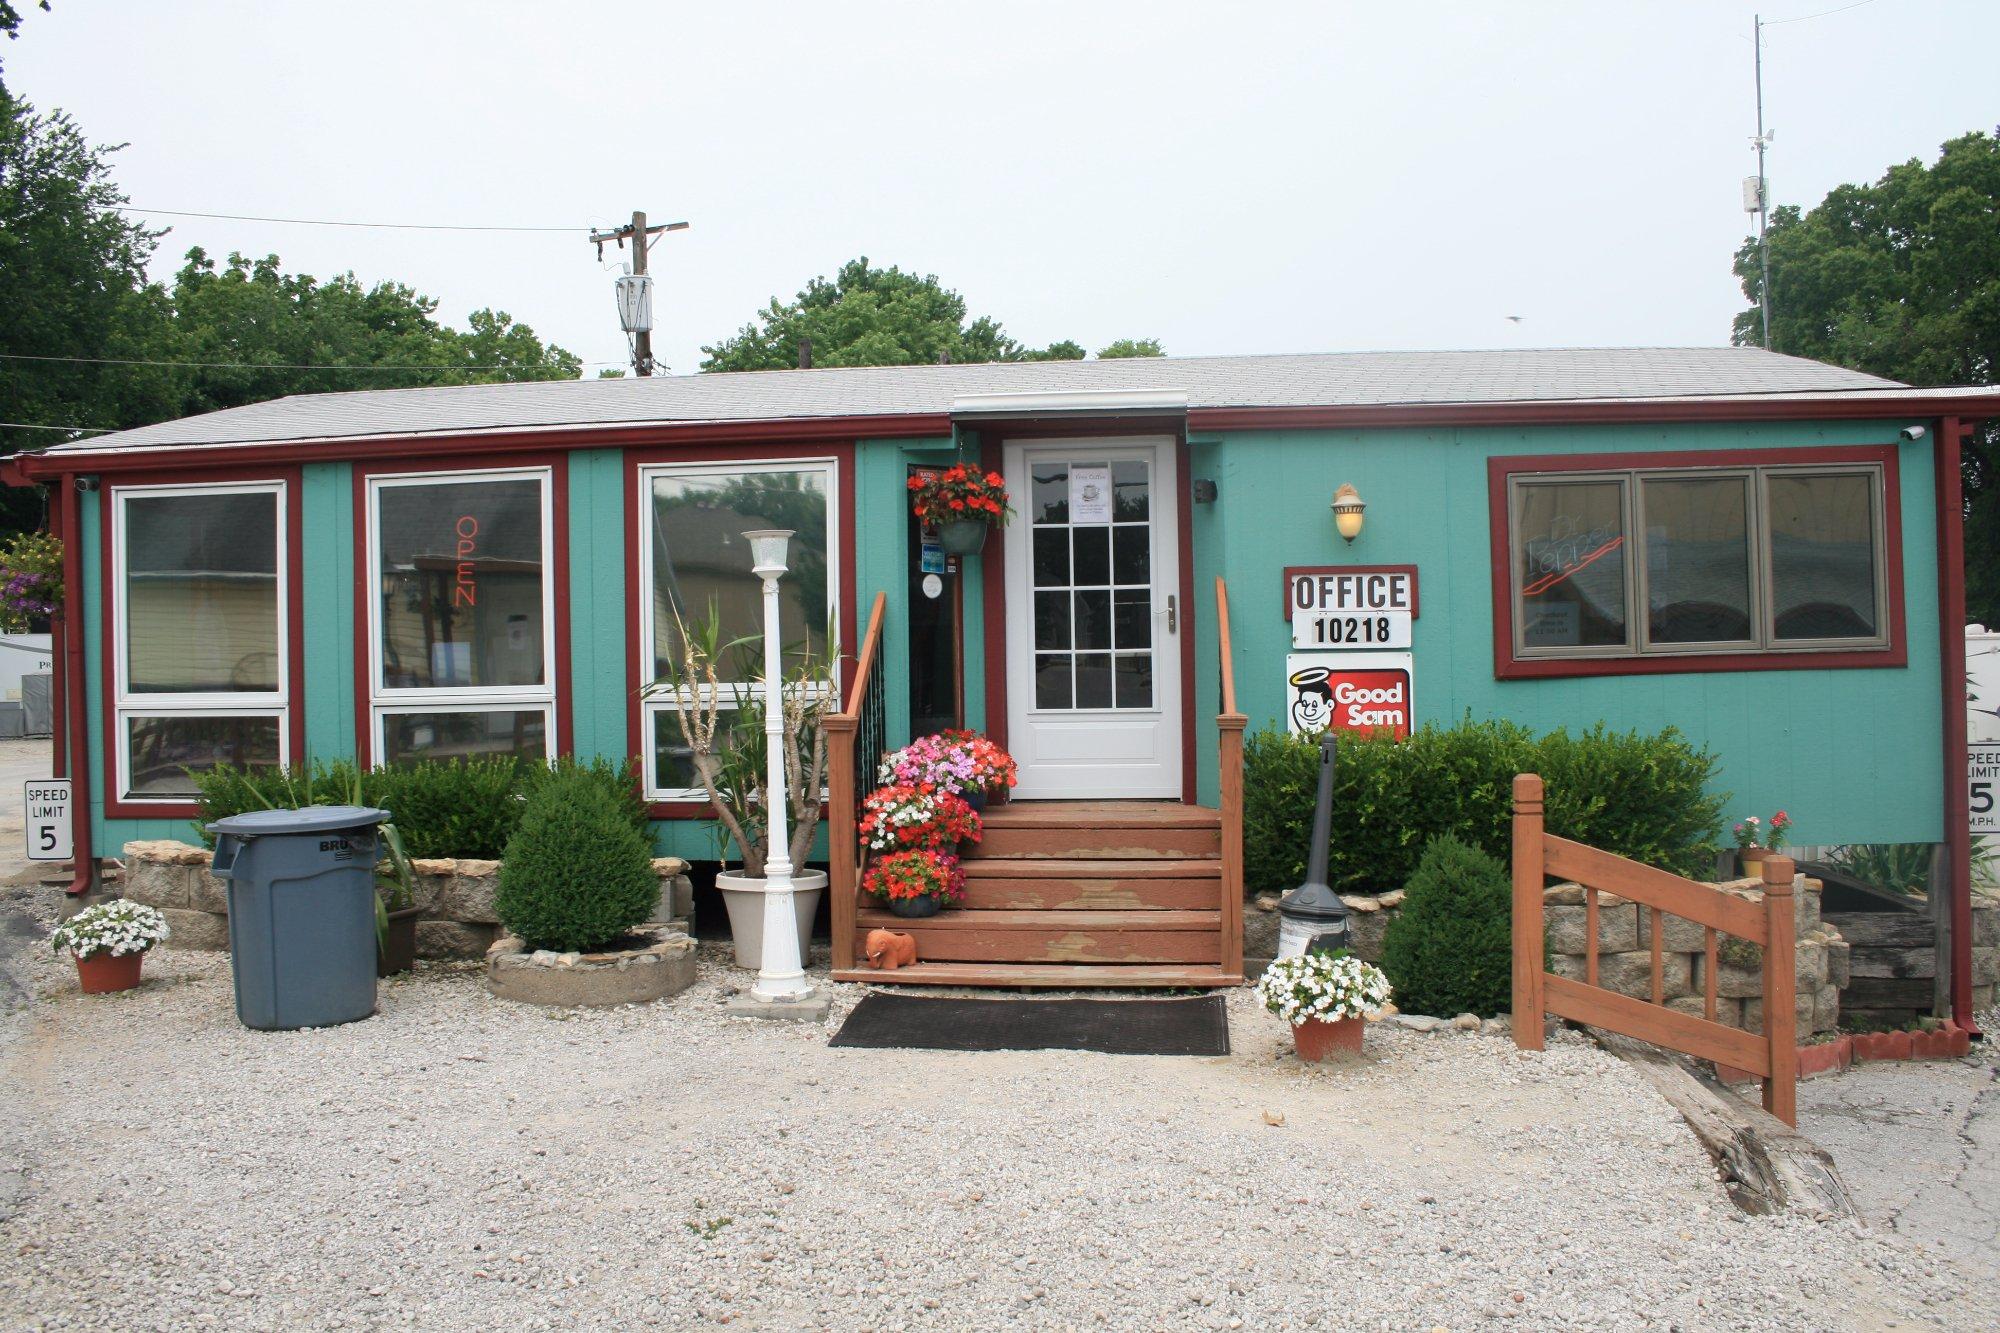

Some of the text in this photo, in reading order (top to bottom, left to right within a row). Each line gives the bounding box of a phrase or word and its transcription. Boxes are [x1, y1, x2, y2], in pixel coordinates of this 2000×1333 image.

[455, 515, 479, 608] OPEN
[1296, 575, 1407, 610] OFFICE
[1314, 617, 1390, 643] 10218
[1335, 682, 1403, 704] Good
[1347, 704, 1403, 726] Sam
[1967, 753, 2000, 764] PEED
[28, 789, 68, 801] SPEED
[1969, 782, 1994, 813] 5
[32, 806, 65, 818] LIMIT
[40, 825, 57, 851] 5
[319, 838, 360, 852] BRU
